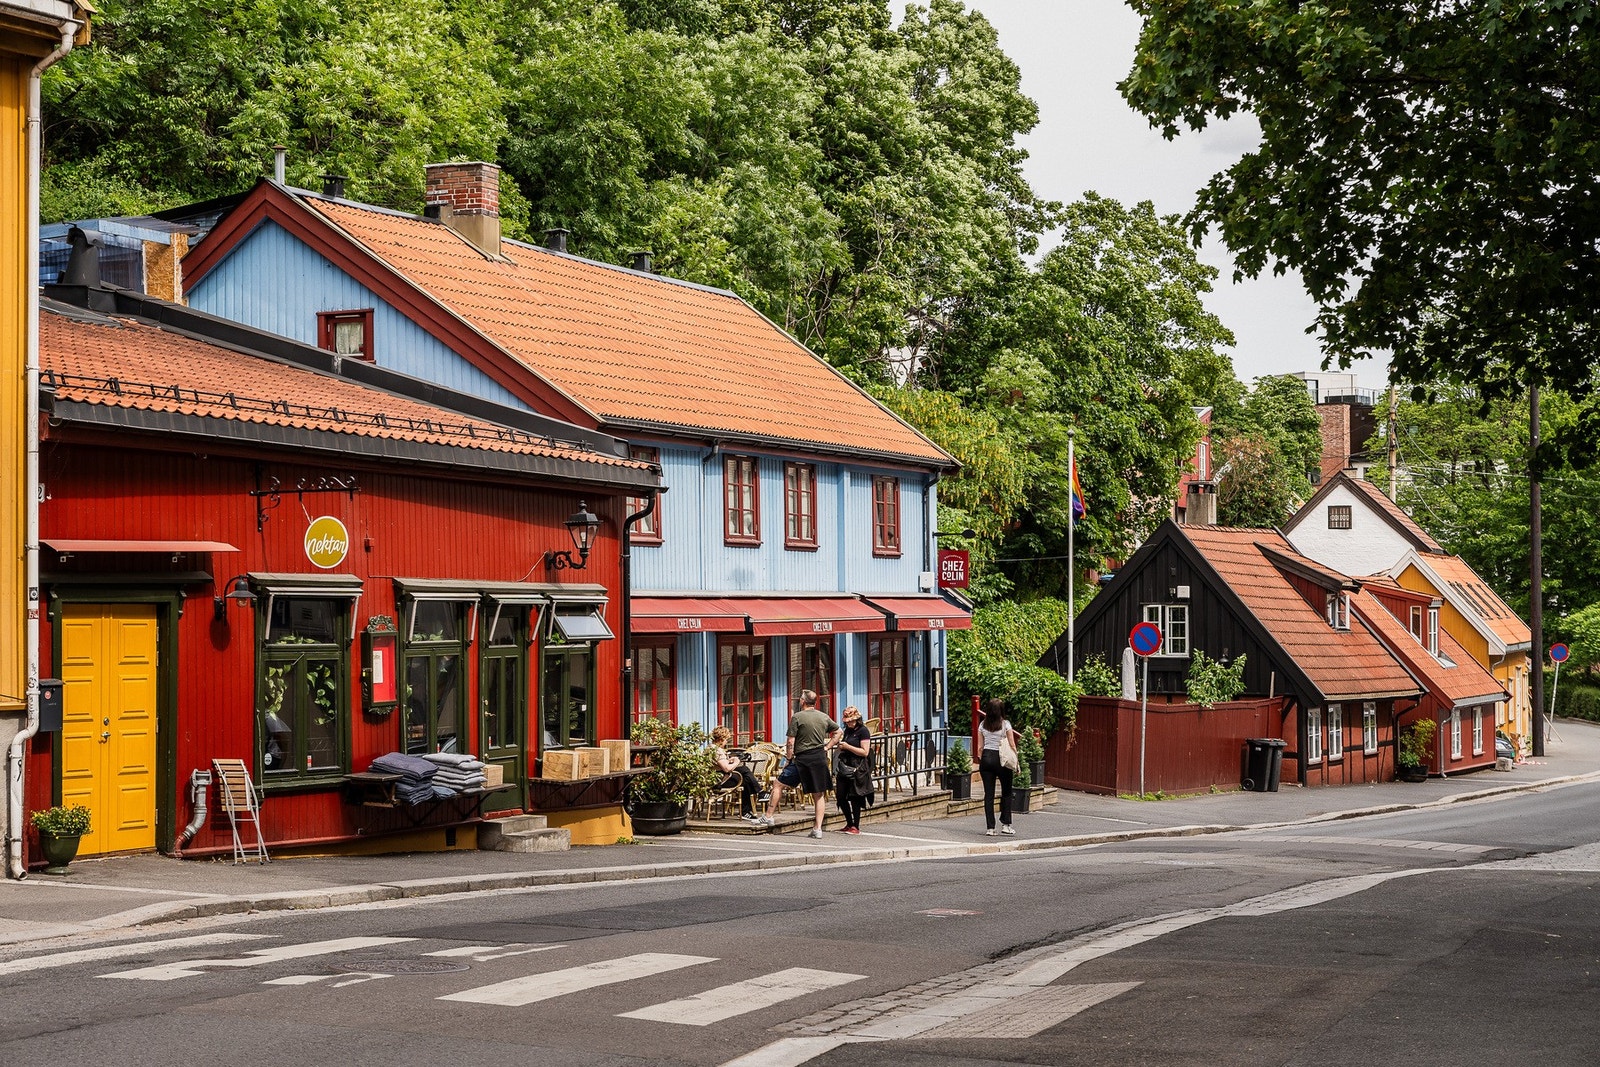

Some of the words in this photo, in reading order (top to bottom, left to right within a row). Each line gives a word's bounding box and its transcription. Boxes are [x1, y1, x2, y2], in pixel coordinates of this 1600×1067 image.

[307, 533, 347, 556] nektar
[942, 560, 964, 572] CHEZ
[677, 618, 689, 629] CHEZ
